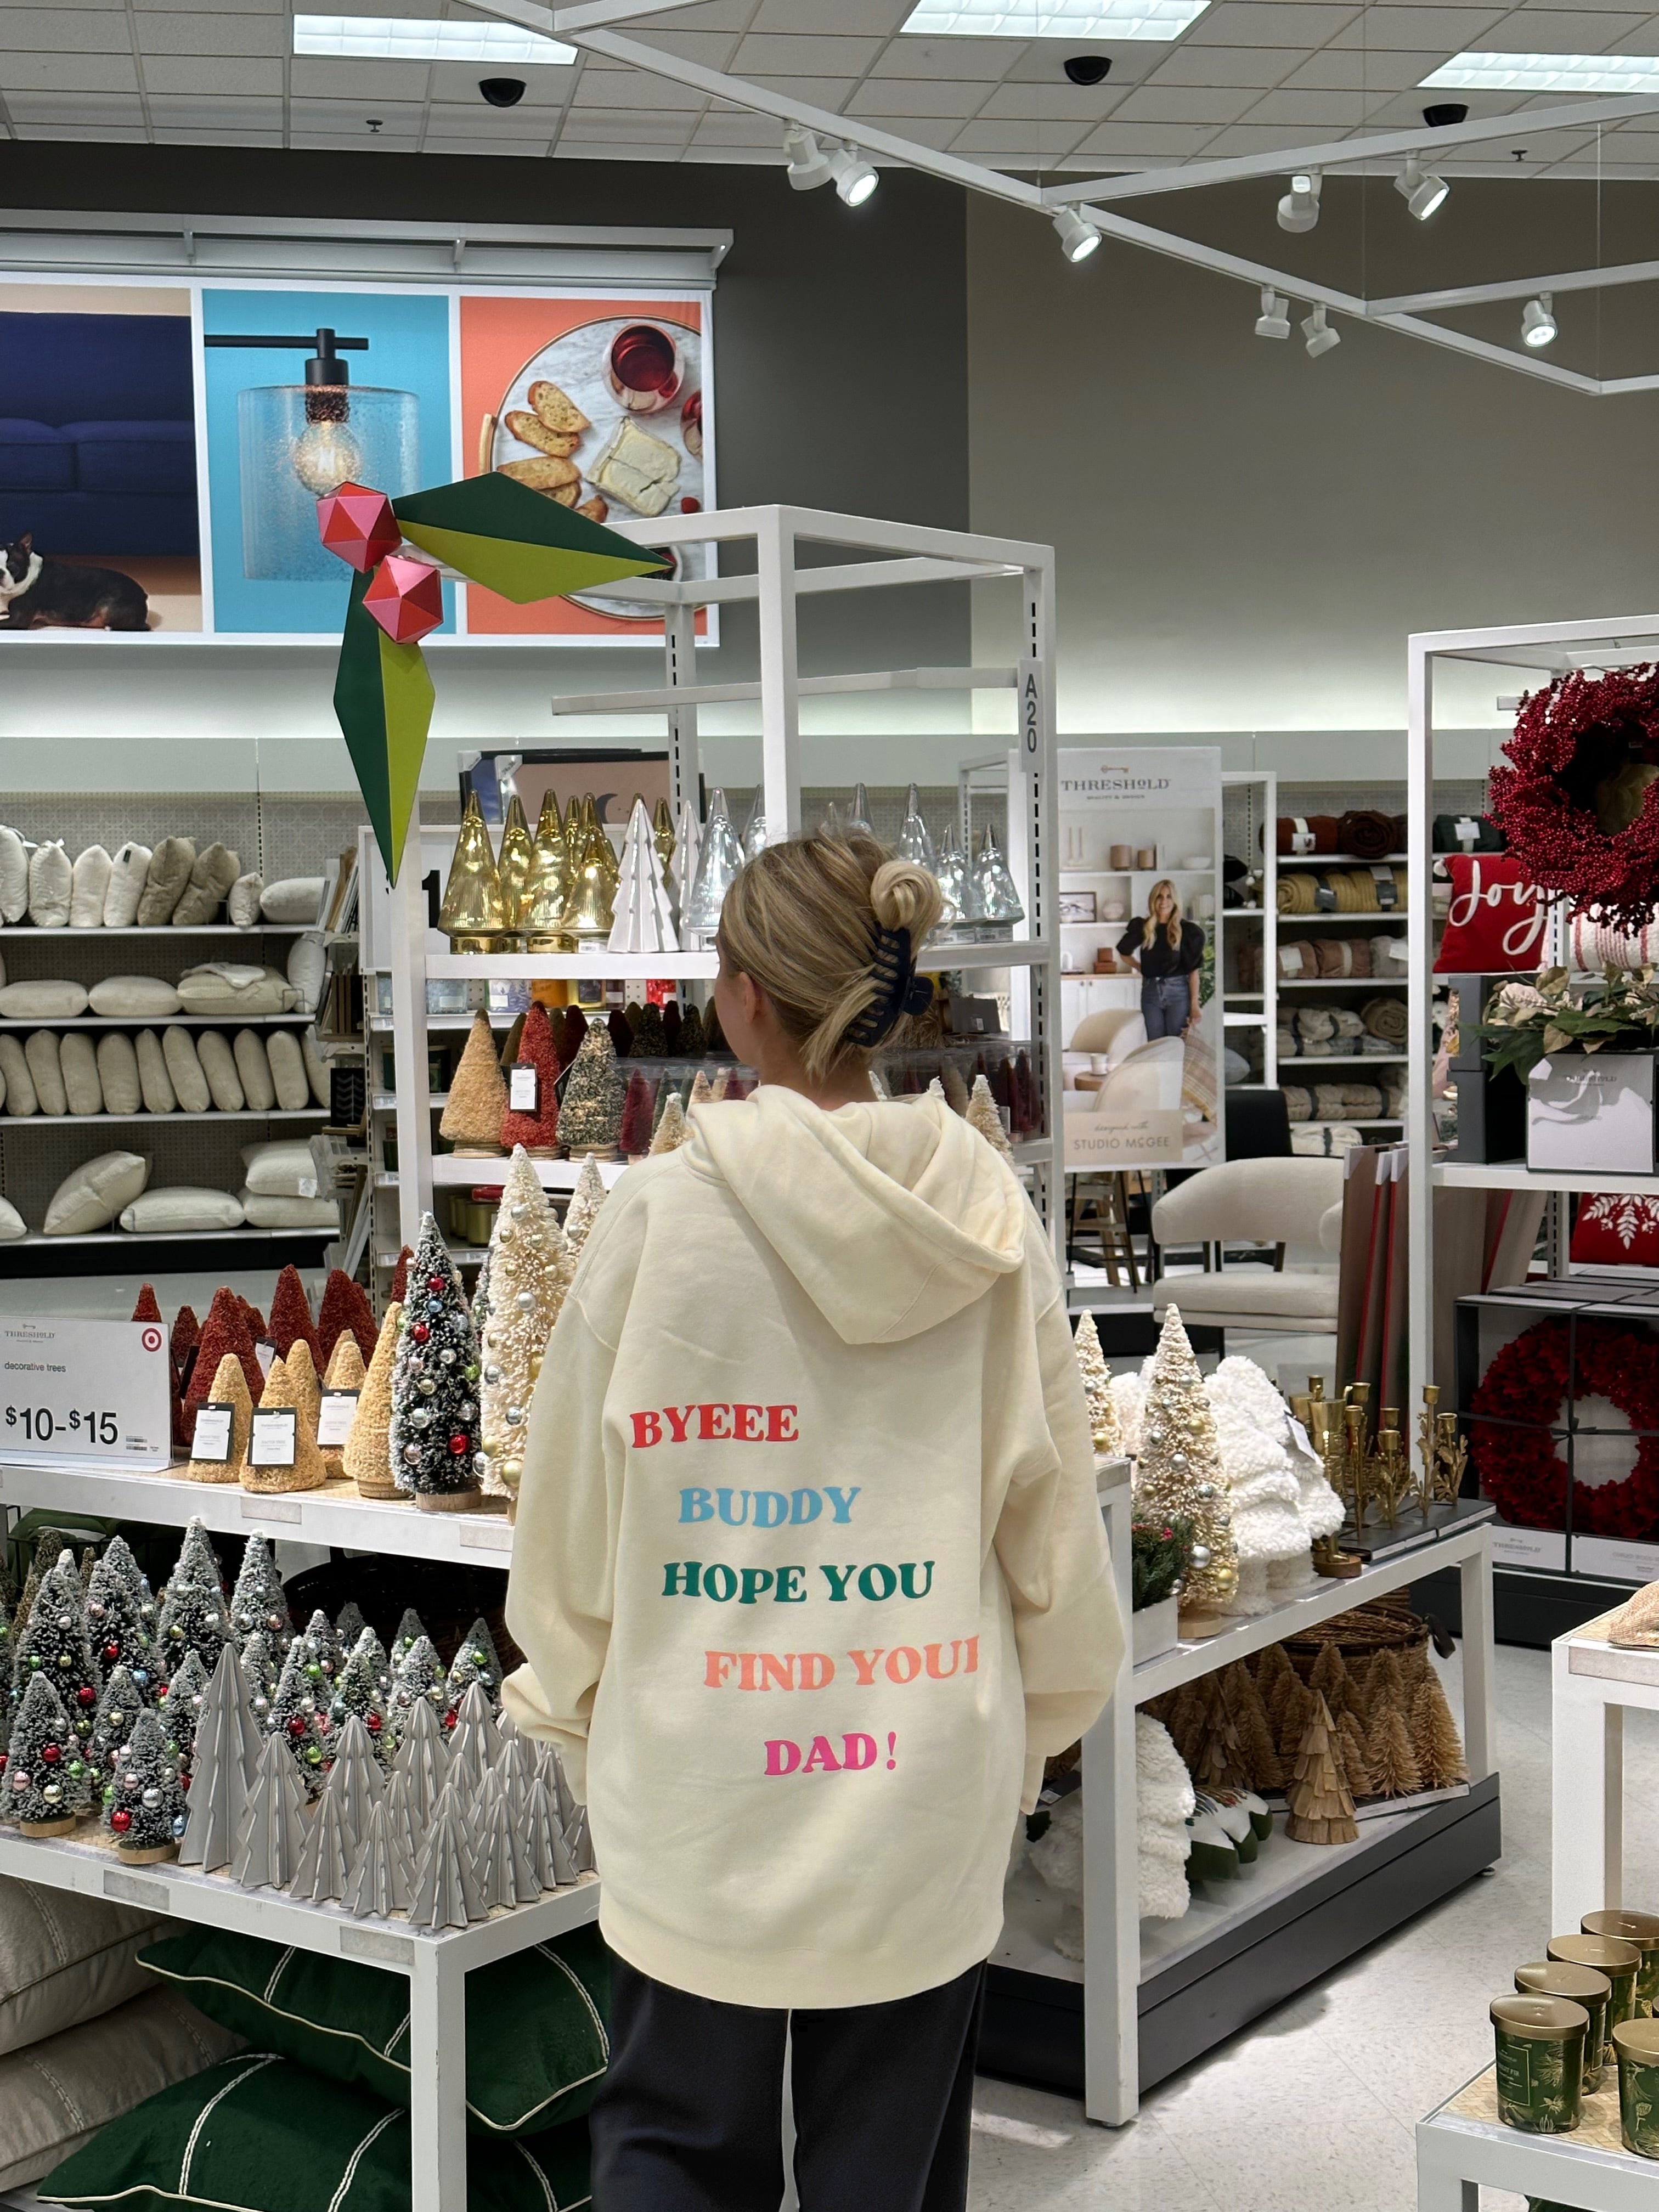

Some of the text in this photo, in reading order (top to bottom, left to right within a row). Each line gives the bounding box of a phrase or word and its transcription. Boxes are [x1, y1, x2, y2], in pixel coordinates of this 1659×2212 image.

[1025, 673, 1037, 753] A20
[1062, 779, 1170, 791] THRESHOLD
[1449, 860, 1548, 956] Joy
[1074, 1138, 1120, 1150] STUDIO
[5, 1330, 55, 1339] THRESHOLD
[4, 1361, 66, 1372] decorative trees
[630, 1403, 799, 1448] BYEEE
[678, 1487, 861, 1527] BUDDY
[662, 1560, 935, 1604] HOPE YOU
[703, 1651, 835, 1691] FIND
[765, 1732, 896, 1775] DAD!
